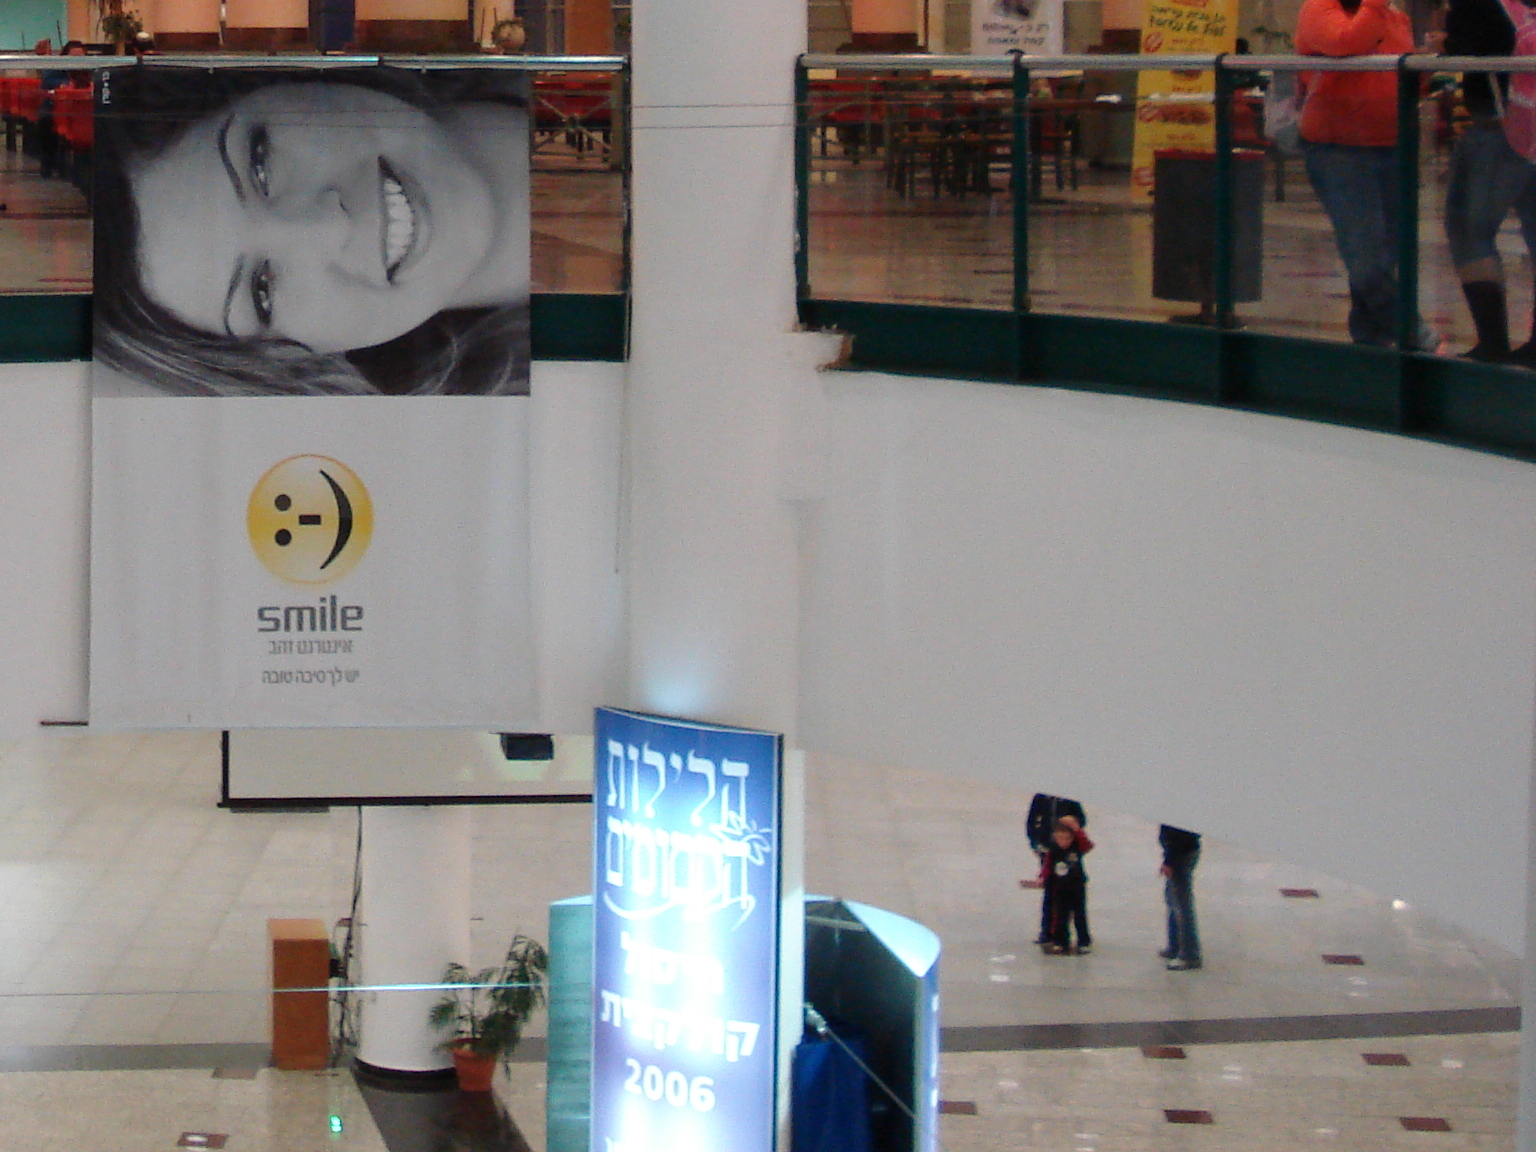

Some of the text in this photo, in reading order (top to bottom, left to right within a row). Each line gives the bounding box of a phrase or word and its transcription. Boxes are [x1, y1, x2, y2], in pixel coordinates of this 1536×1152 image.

[257, 594, 364, 632] smile
[268, 639, 354, 654] אינטרנט זהב
[261, 669, 294, 684] טובה
[295, 668, 327, 684] סיבה
[344, 668, 360, 683] יש
[624, 1058, 717, 1113] 2006
